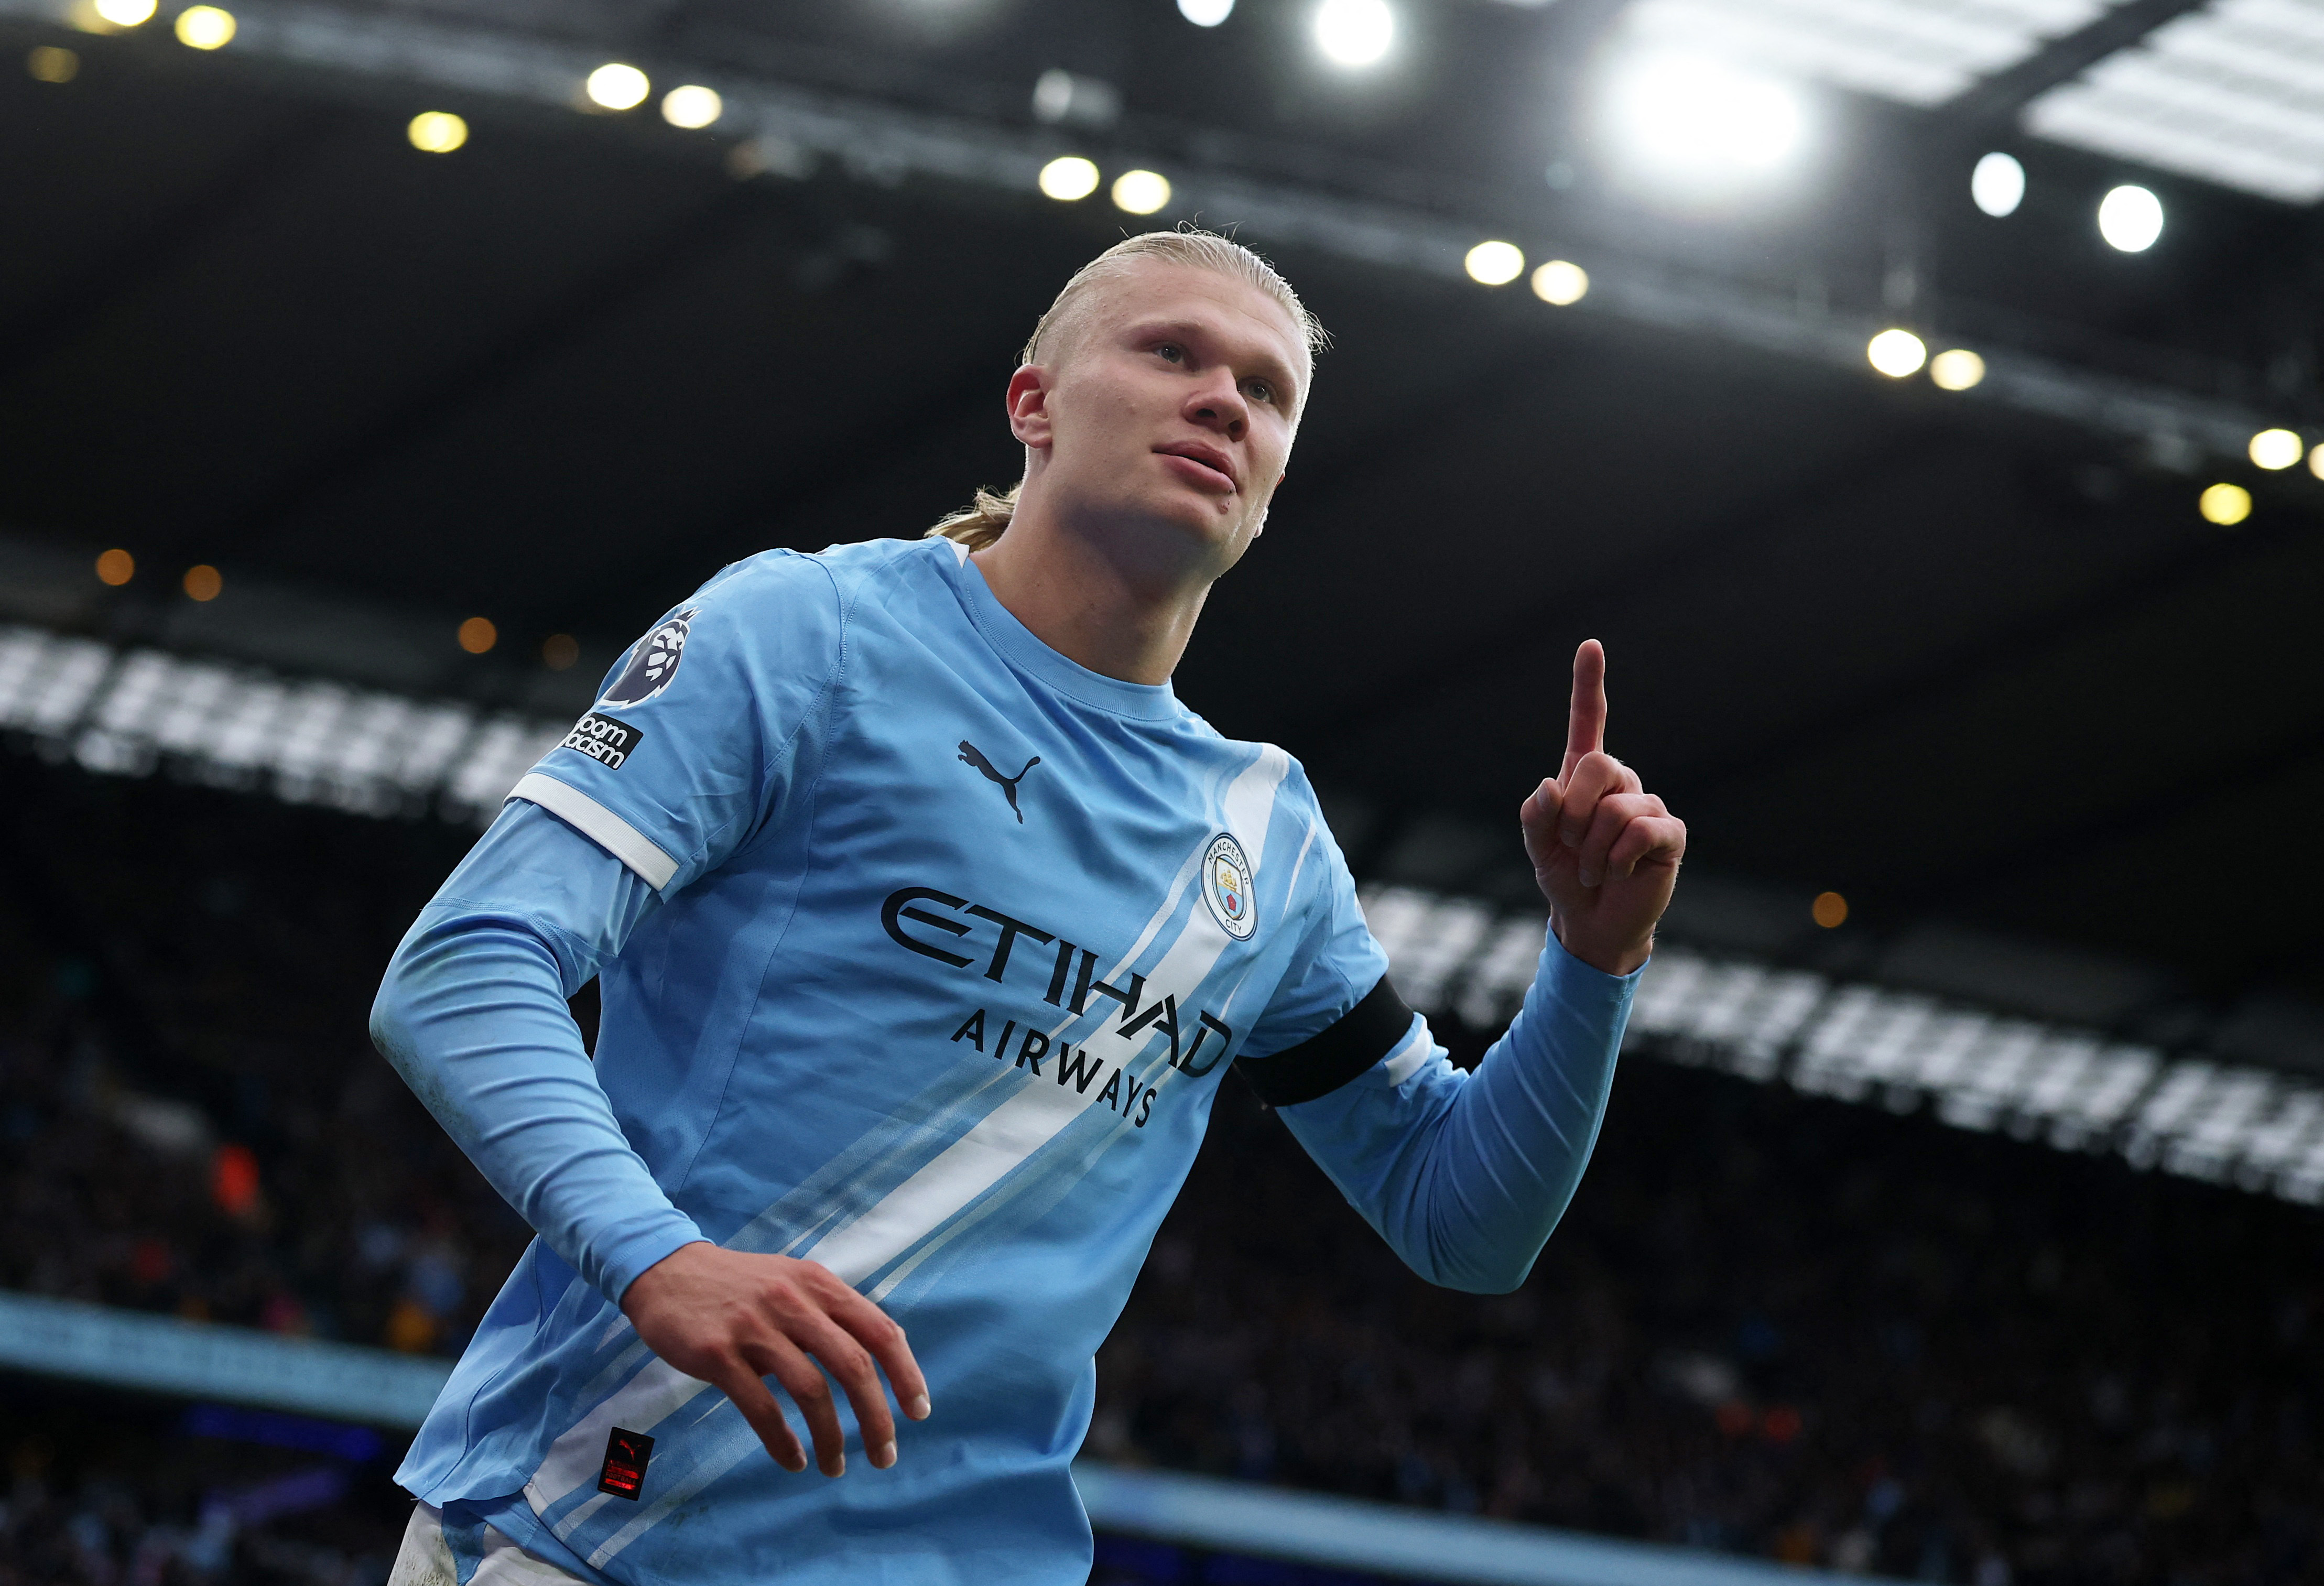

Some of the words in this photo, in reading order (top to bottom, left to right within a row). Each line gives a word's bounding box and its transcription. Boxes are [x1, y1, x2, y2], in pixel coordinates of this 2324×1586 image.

[578, 716, 627, 747] oom
[564, 733, 624, 769] acism
[1208, 841, 1250, 886] MANCHESTER
[1225, 919, 1242, 934] CITY
[881, 887, 1232, 1079] ETIHAD
[950, 1008, 1157, 1128] AIRWAYS
[605, 1472, 636, 1484] FOOTBALL
